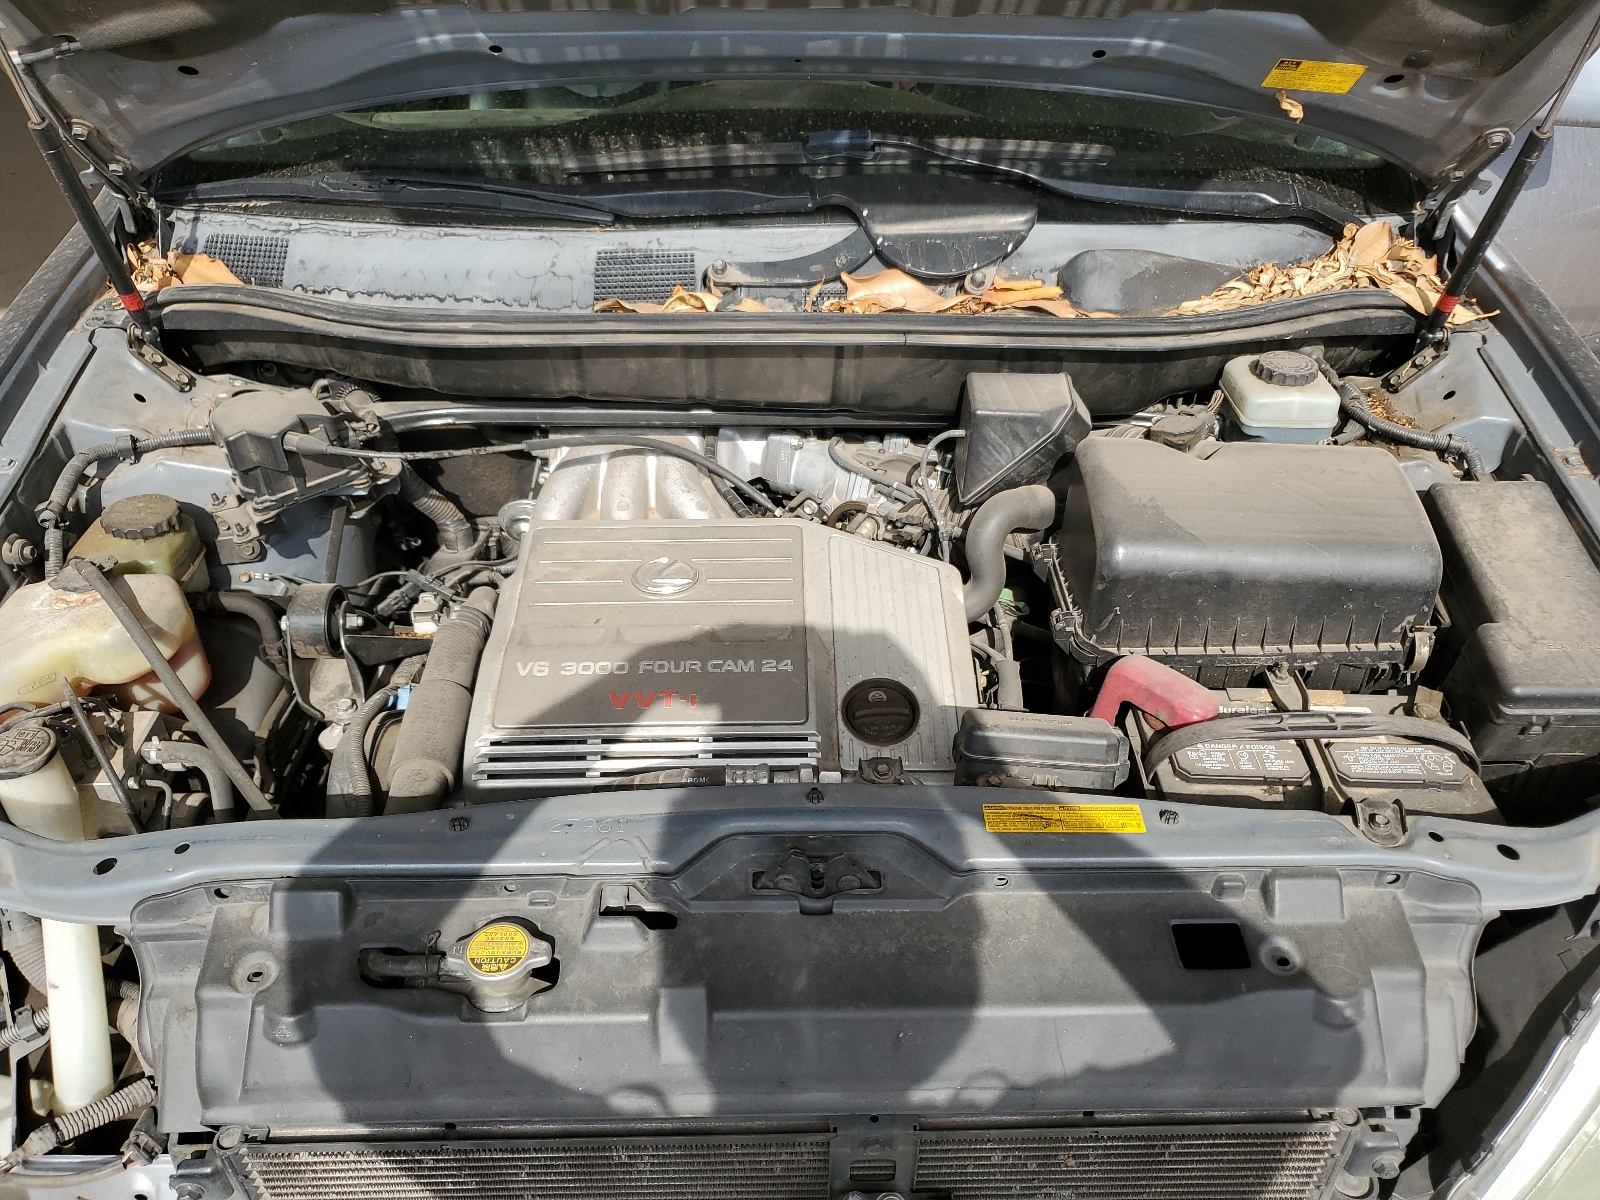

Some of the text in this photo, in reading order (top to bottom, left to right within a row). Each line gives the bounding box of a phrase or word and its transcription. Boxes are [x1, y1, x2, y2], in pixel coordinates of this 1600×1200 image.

[516, 659, 794, 676] V6 3000 FOUR CAM 24
[608, 690, 699, 709] VVT-i
[548, 818, 625, 833] 27961
